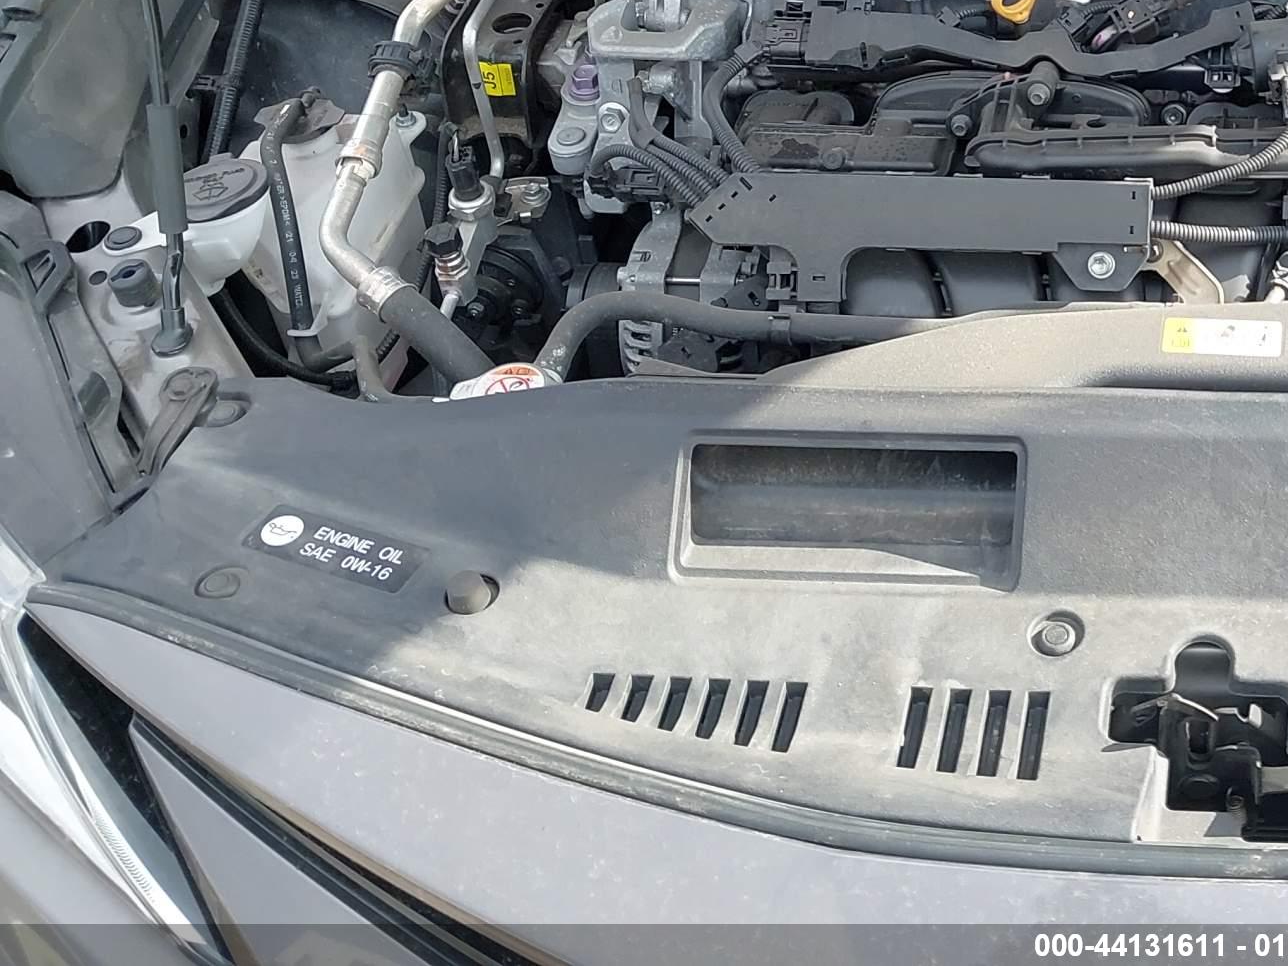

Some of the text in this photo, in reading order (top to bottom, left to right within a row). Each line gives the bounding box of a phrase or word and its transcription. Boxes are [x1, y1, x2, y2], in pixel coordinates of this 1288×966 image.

[482, 71, 497, 90] J5
[299, 542, 393, 580] SAE 0W-16
[314, 526, 403, 565] ENGINE OIL
